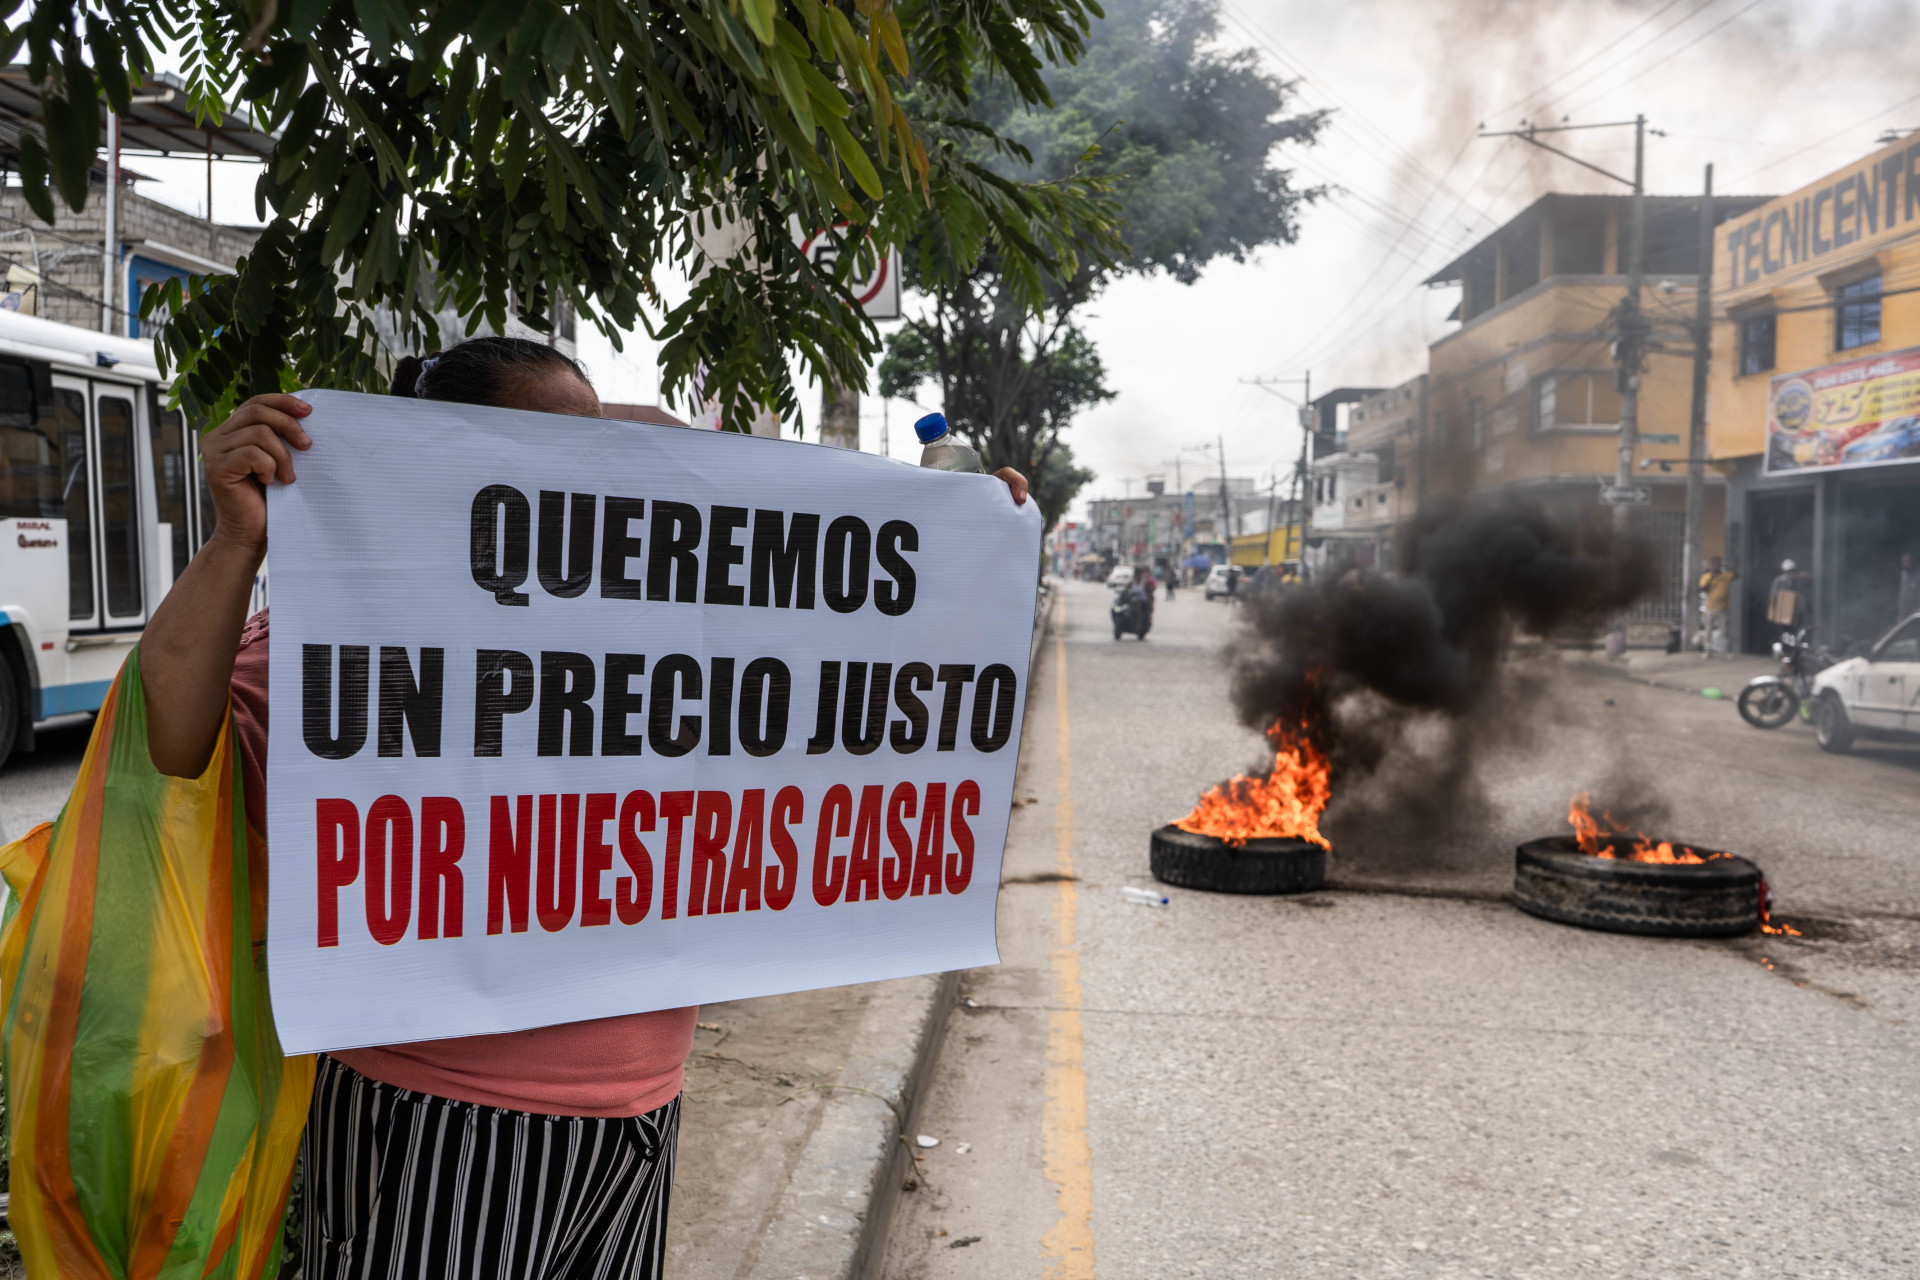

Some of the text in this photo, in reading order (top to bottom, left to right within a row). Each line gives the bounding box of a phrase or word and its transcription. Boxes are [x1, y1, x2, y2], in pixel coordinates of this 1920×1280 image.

[1727, 142, 1920, 290] TECNICENTR
[470, 484, 919, 616] QUEREMOS
[302, 644, 1018, 760] UN PRECIO JUSTO
[316, 780, 981, 947] POR NUESTRAS CASAS
